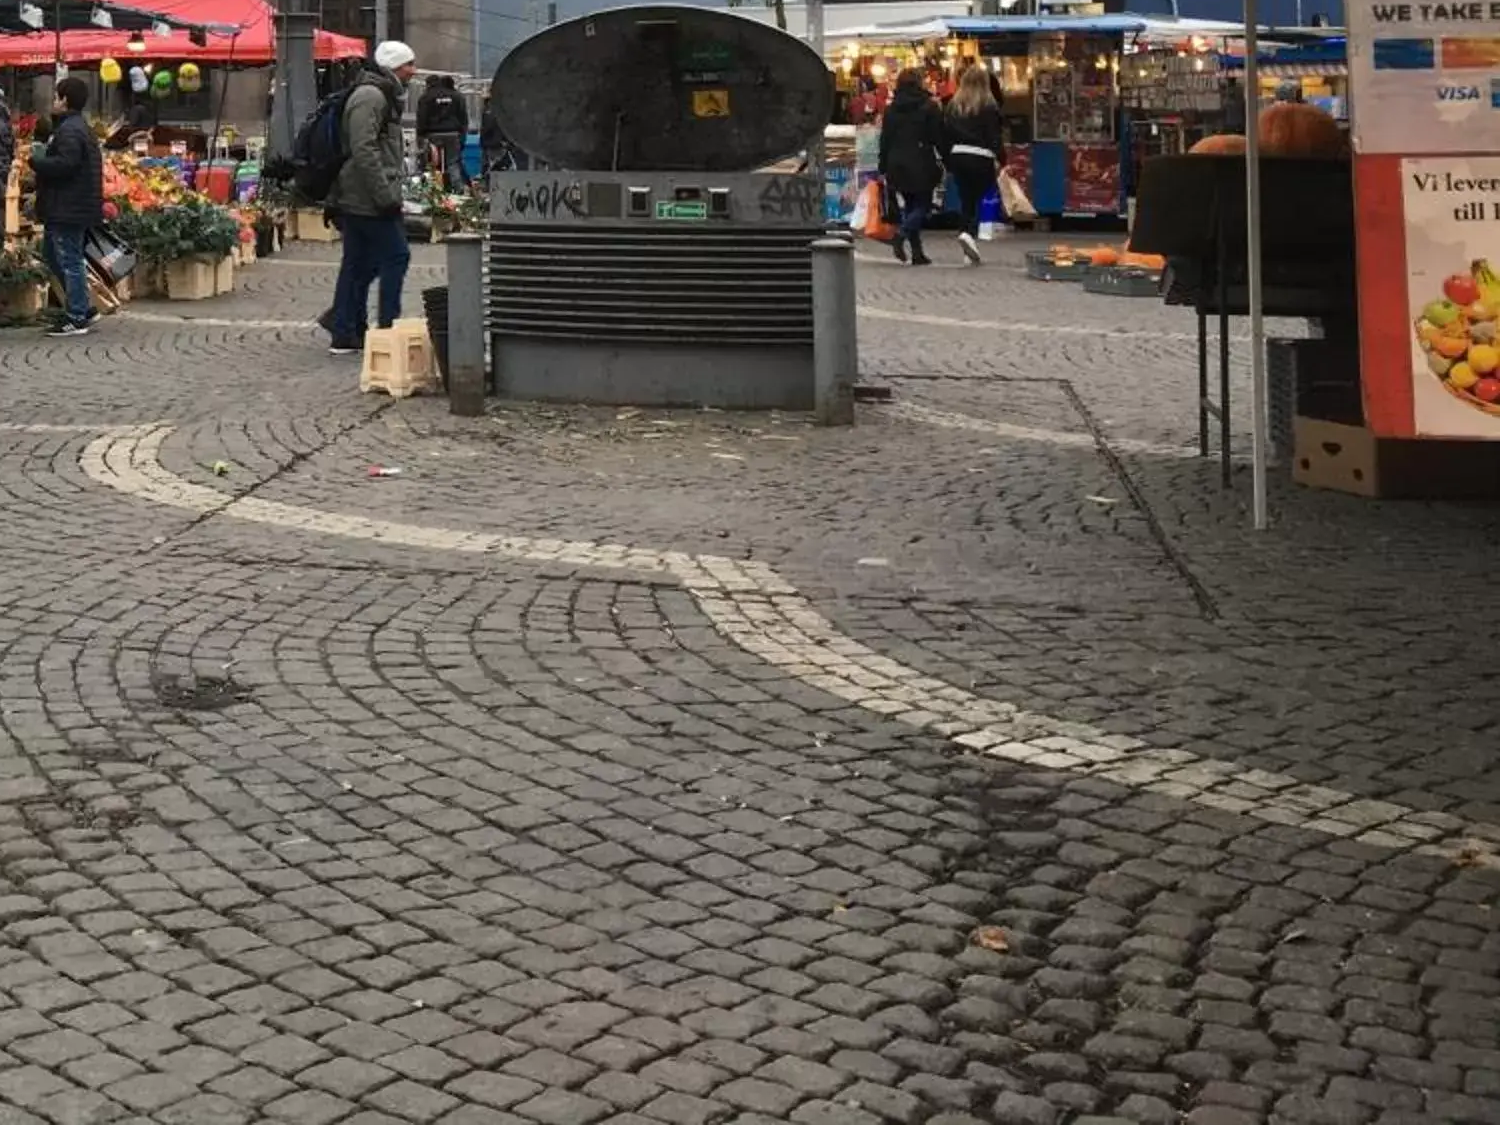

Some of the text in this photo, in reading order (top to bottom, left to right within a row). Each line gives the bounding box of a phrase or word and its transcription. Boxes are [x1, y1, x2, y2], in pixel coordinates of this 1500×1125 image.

[1371, 4, 1412, 22] WE
[1419, 2, 1483, 22] TAKE
[1436, 85, 1480, 101] VISA
[1412, 172, 1438, 191] Vi
[1453, 202, 1485, 221] till
